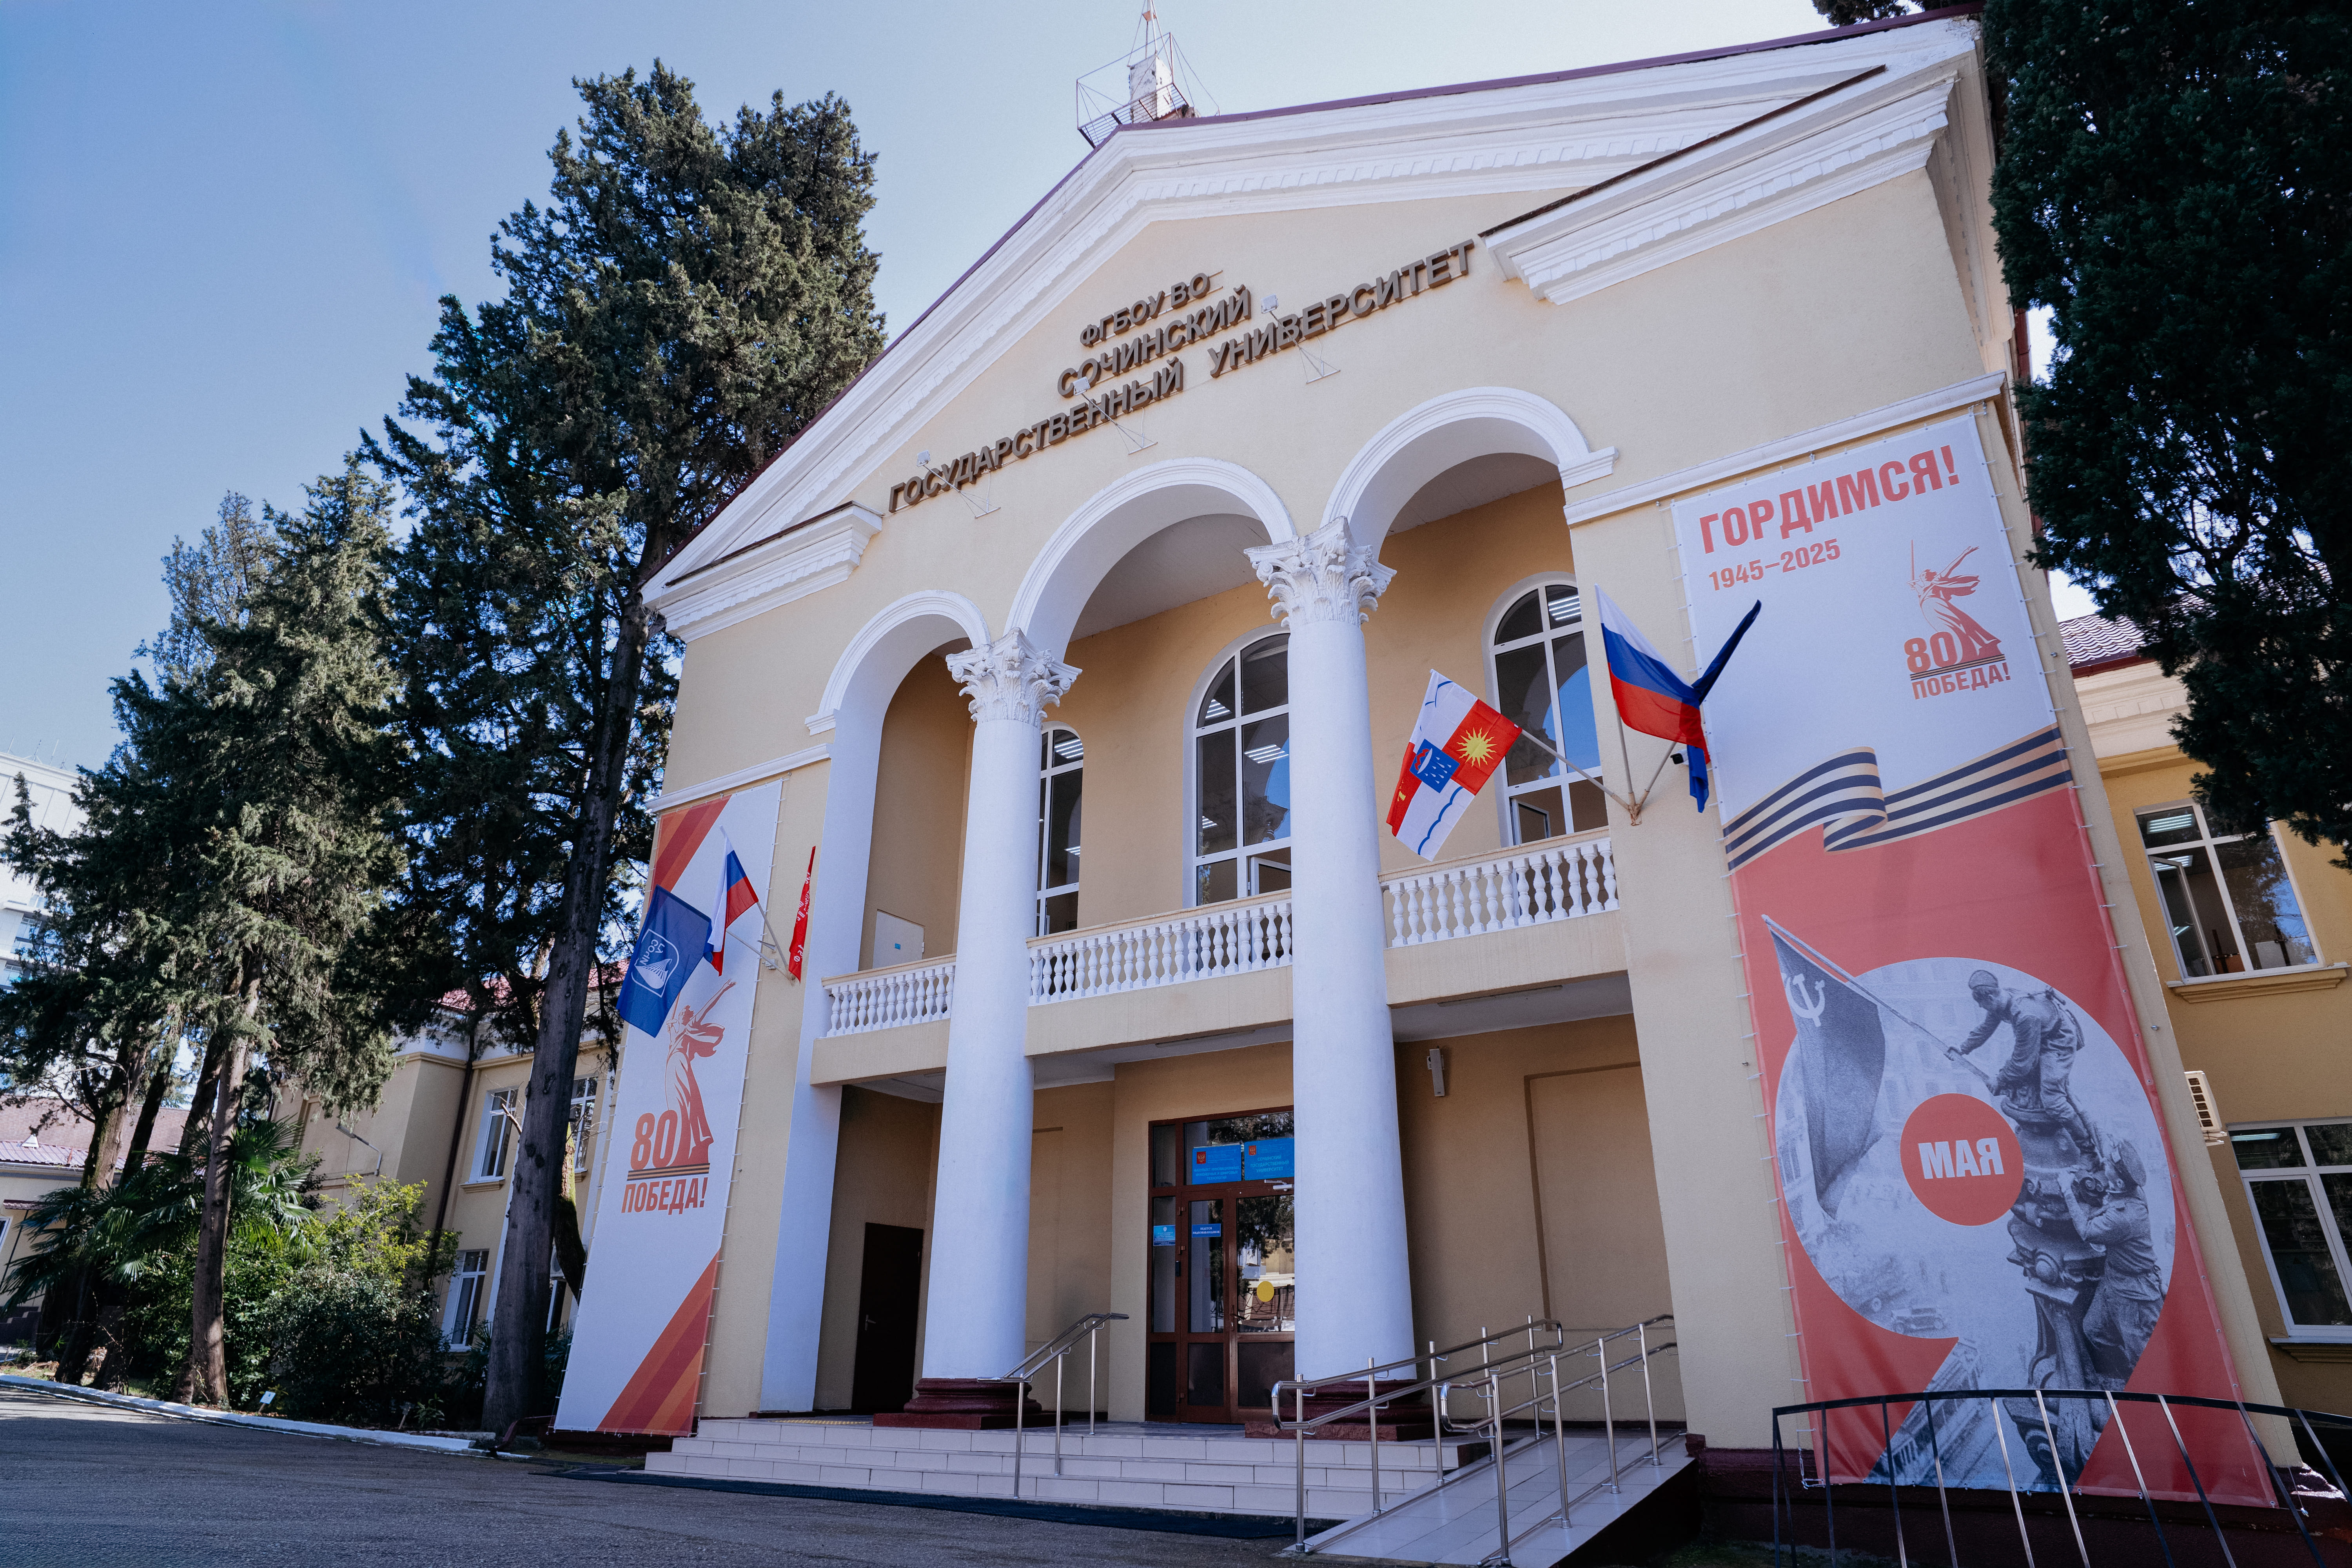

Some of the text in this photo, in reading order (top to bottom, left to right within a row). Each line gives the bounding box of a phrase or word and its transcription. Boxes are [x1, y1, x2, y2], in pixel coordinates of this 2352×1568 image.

[1080, 272, 1210, 347] ФГБОУ ВО
[1057, 284, 1251, 398] СОЧИНСКИЙ
[889, 238, 1474, 513] ГОСУДАРСТВЕННЫЙ УНИВЕРСИТЕТ
[1699, 445, 1960, 554] ГОРДИМСЯ!
[1904, 631, 1958, 673] 80
[1912, 662, 2011, 700] ПОБЕДА!
[631, 1110, 677, 1171] 80
[1918, 1137, 2004, 1180] МАЯ
[621, 1177, 708, 1216] ПОБЕДА!
